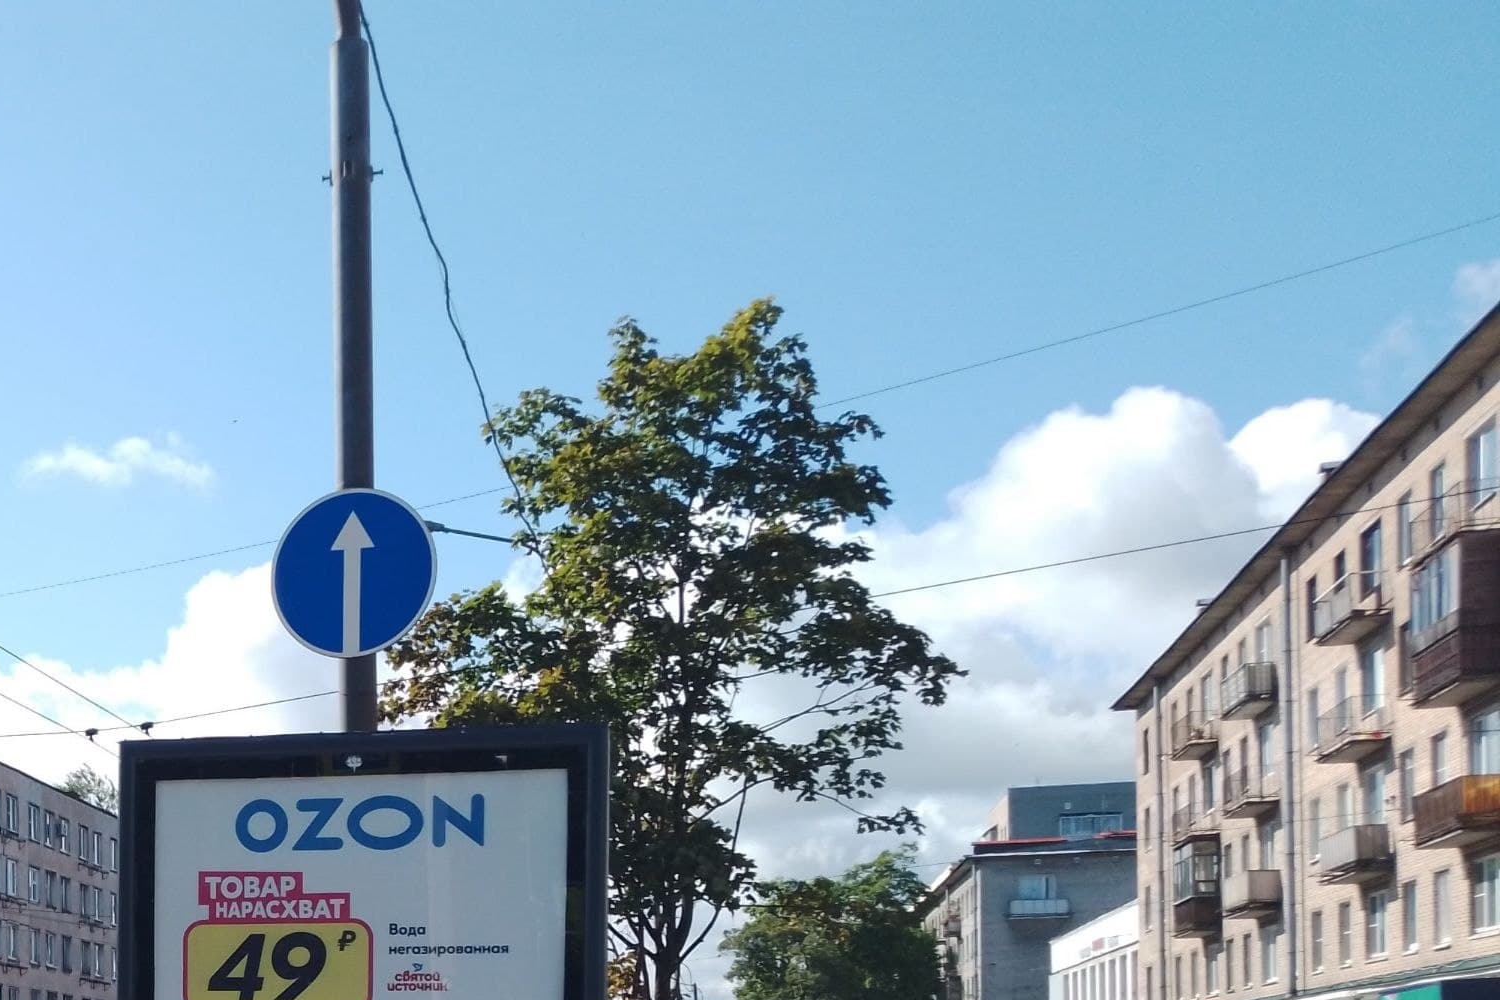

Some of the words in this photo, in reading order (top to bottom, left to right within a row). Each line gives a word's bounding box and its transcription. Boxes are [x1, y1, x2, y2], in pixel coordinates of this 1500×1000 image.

[235, 793, 485, 853] OZON
[205, 876, 296, 899] ТОВАР
[215, 898, 345, 919] НАРАСХВАТ
[389, 923, 426, 937] Вода
[388, 944, 509, 957] негазированная
